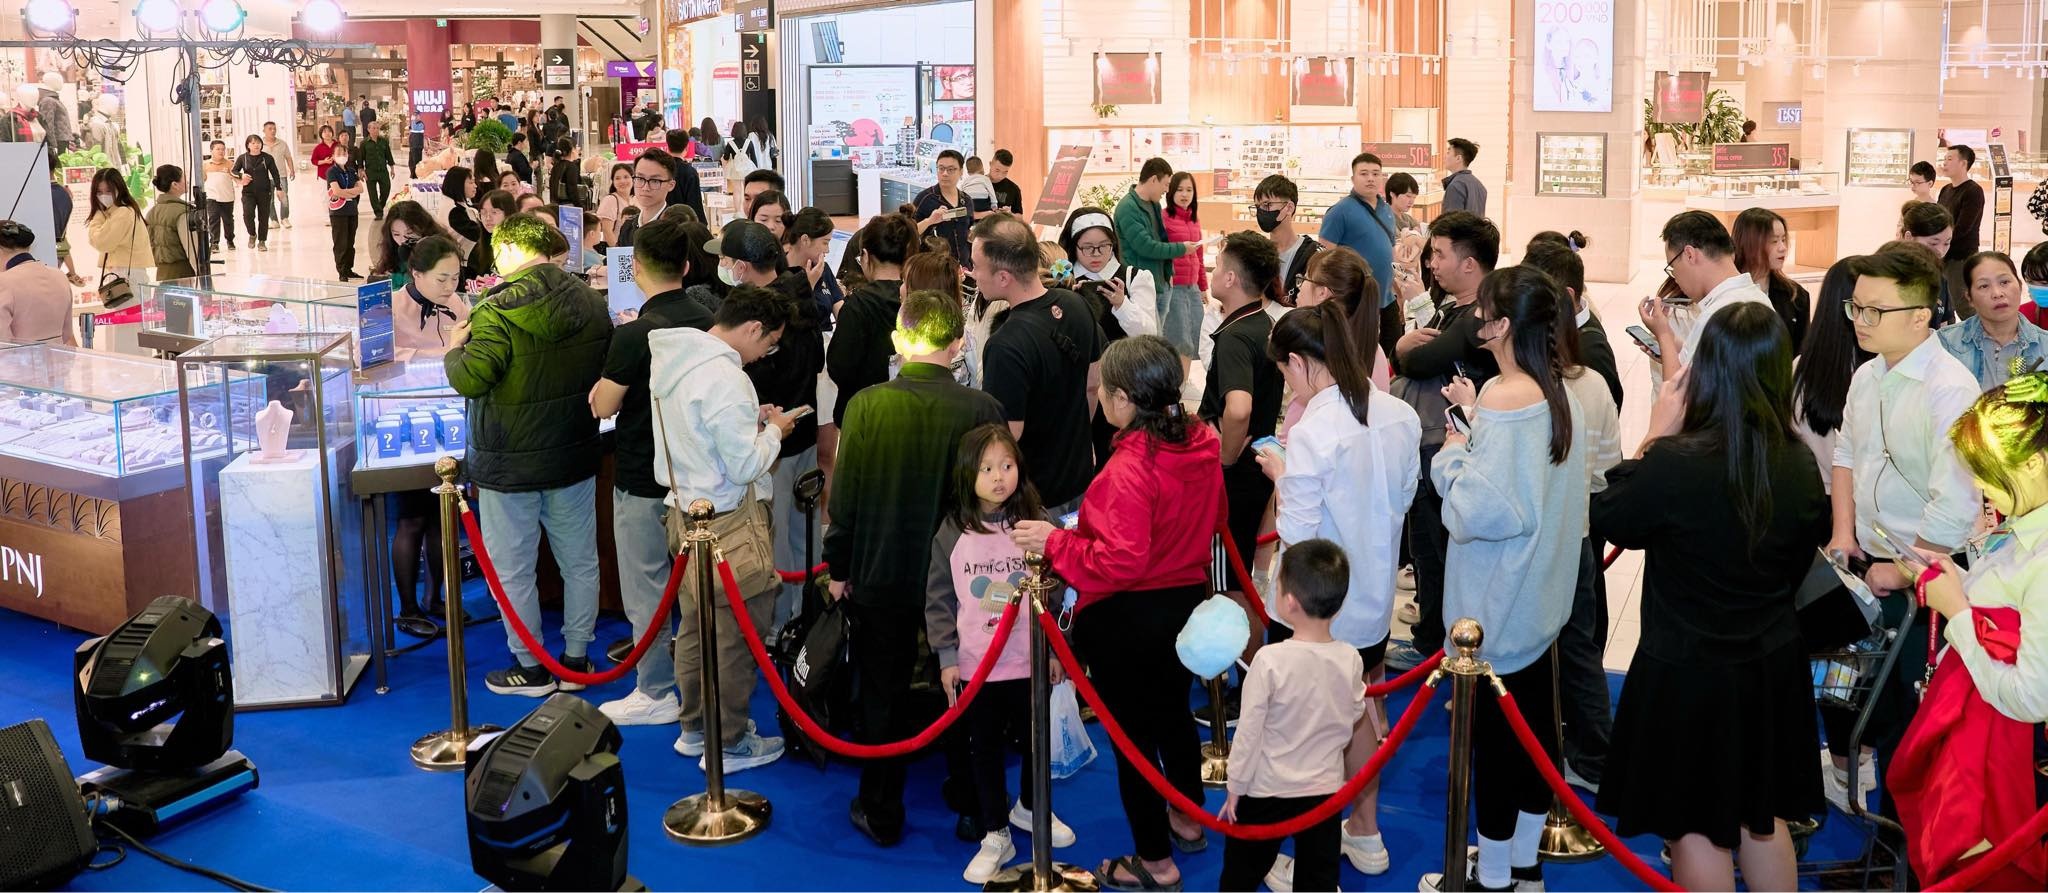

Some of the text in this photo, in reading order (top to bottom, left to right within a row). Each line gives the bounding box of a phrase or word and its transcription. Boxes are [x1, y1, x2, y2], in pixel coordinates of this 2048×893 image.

[1539, 2, 1583, 23] 200
[413, 90, 446, 105] MUJI
[383, 433, 393, 448] ?
[419, 429, 429, 444] ?
[450, 426, 459, 441] ?
[1, 545, 43, 599] PNJ
